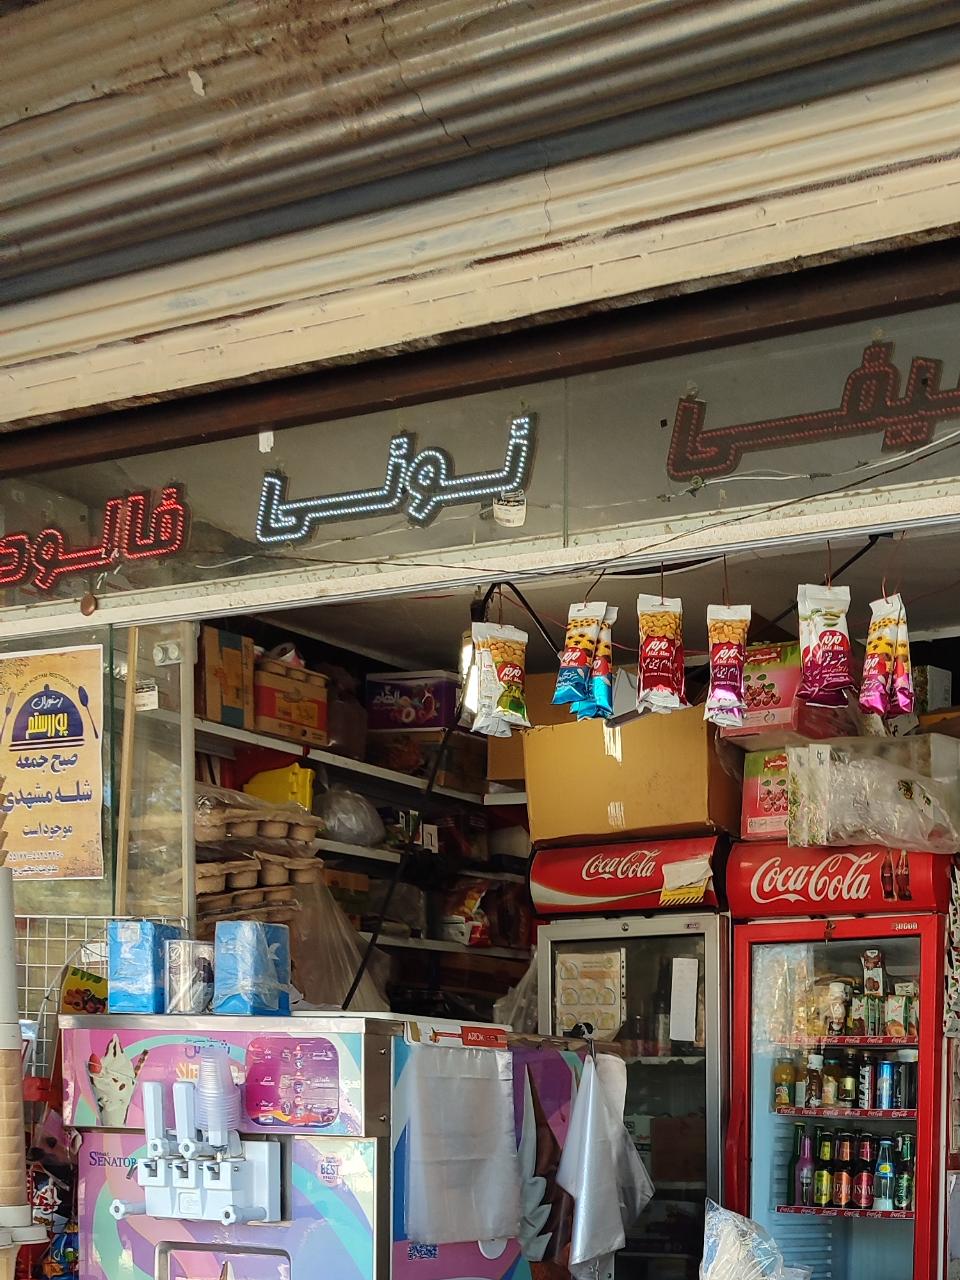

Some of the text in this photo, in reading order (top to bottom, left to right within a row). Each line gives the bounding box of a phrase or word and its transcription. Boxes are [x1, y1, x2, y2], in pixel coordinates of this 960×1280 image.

[0, 483, 190, 590] فالود
[31, 696, 63, 710] رستوران
[16, 752, 79, 773] صبح جمعه
[0, 779, 93, 813] شله مشهدی
[22, 820, 73, 840] موجود است
[582, 850, 661, 880] Coca-Cola
[750, 853, 881, 903] Coca-Cola
[89, 1151, 137, 1168] SENATOR
